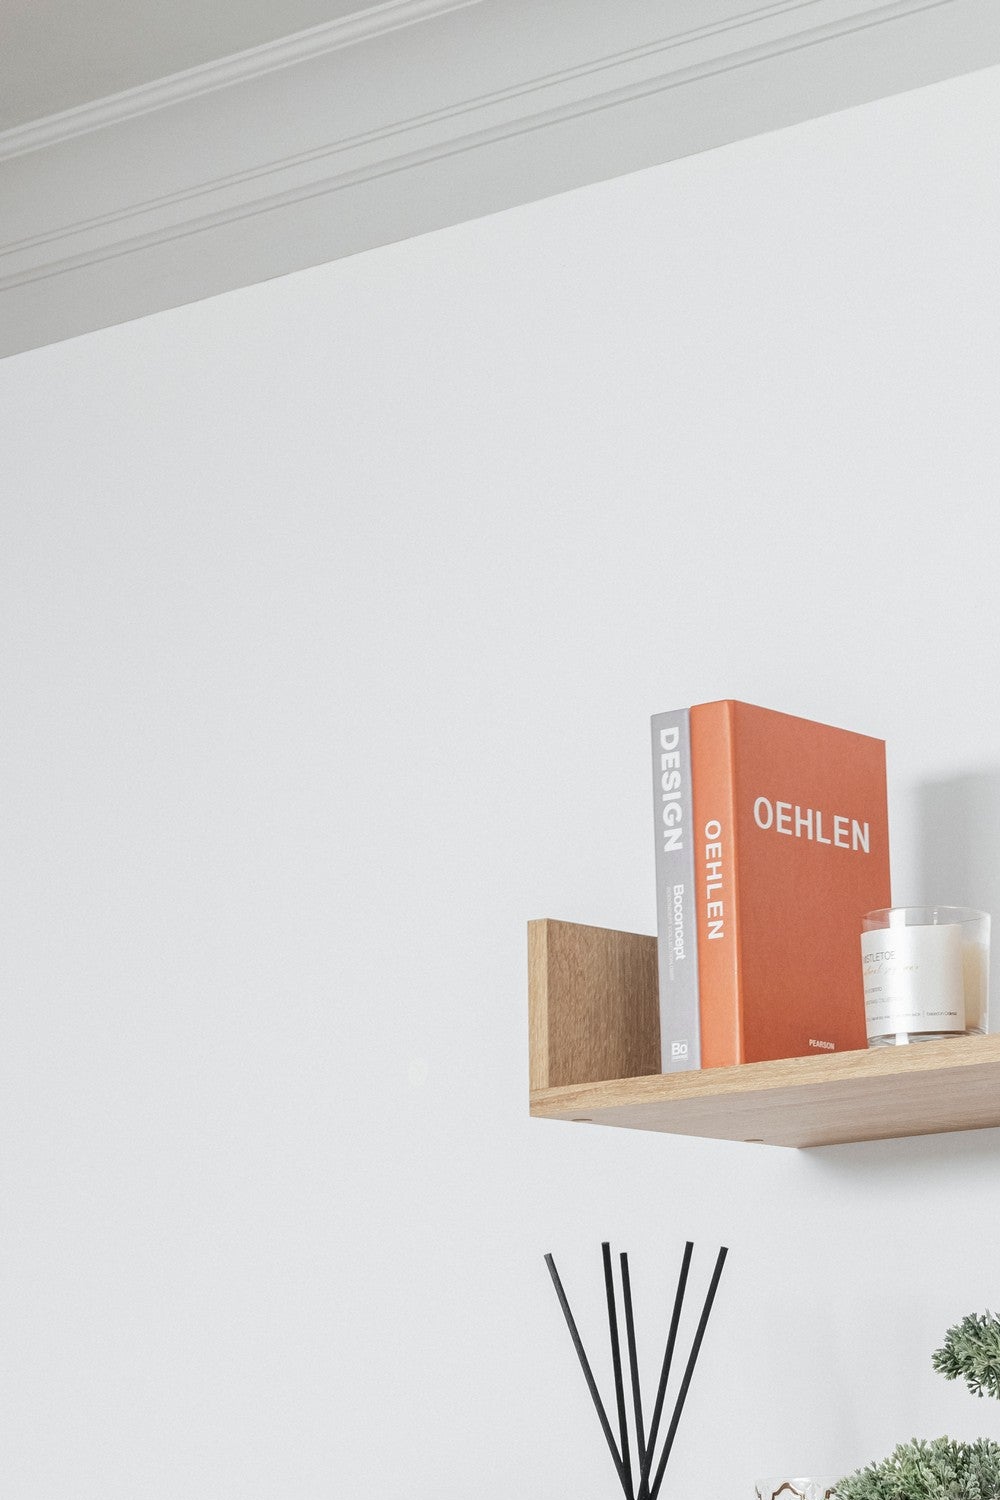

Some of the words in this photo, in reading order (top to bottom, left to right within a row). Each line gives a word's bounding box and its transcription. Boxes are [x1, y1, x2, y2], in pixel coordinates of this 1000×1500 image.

[660, 726, 684, 852] DESIGN
[753, 796, 871, 853] OEHLEN
[704, 819, 724, 940] OEHLEN
[673, 884, 687, 961] Boconcept
[808, 1038, 836, 1051] PEARSON
